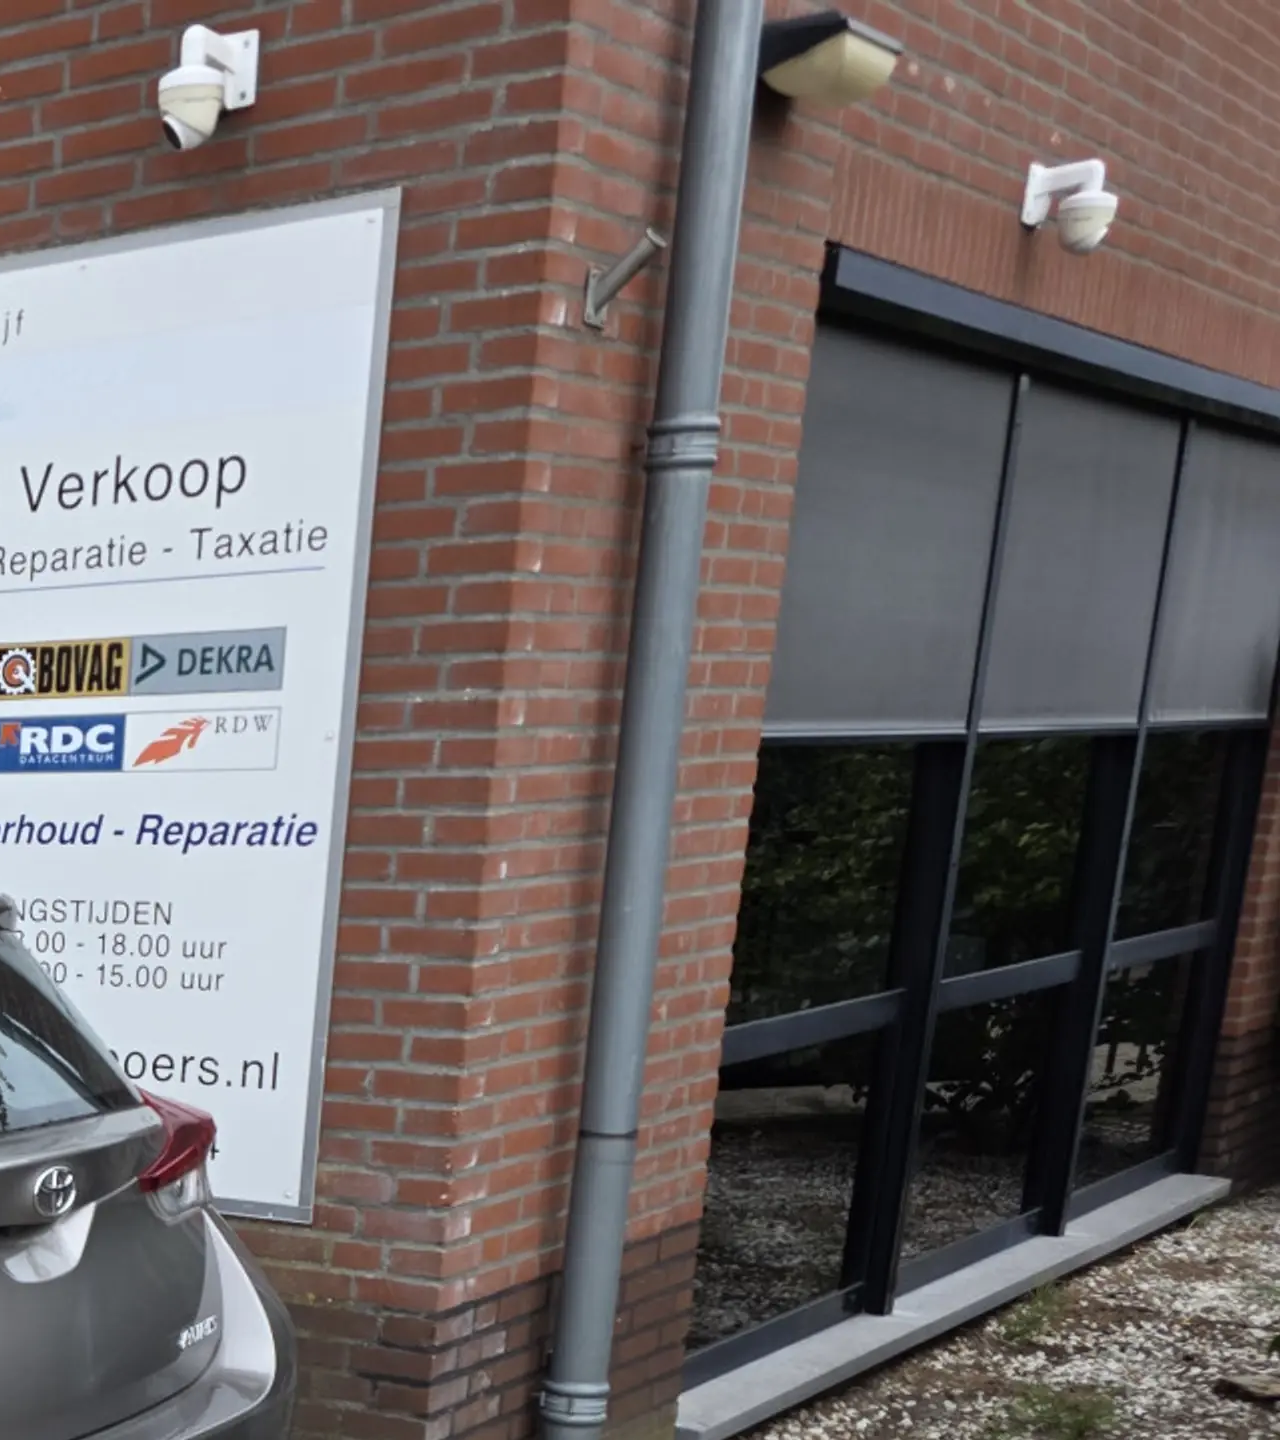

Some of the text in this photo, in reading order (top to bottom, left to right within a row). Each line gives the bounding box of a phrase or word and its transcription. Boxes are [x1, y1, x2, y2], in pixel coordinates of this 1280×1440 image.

[20, 453, 248, 513] Verkoop
[190, 519, 329, 561] Taxatie
[38, 642, 124, 694] BOVAG
[177, 643, 275, 677] DEKRA
[19, 724, 115, 755] RDC
[214, 713, 274, 735] RDW
[19, 753, 115, 765] DATACENTRUM
[135, 814, 319, 855] Reparatie
[97, 932, 171, 958] 18.00
[182, 938, 228, 960] uur
[96, 963, 168, 989] 15.00
[180, 970, 226, 992] uur
